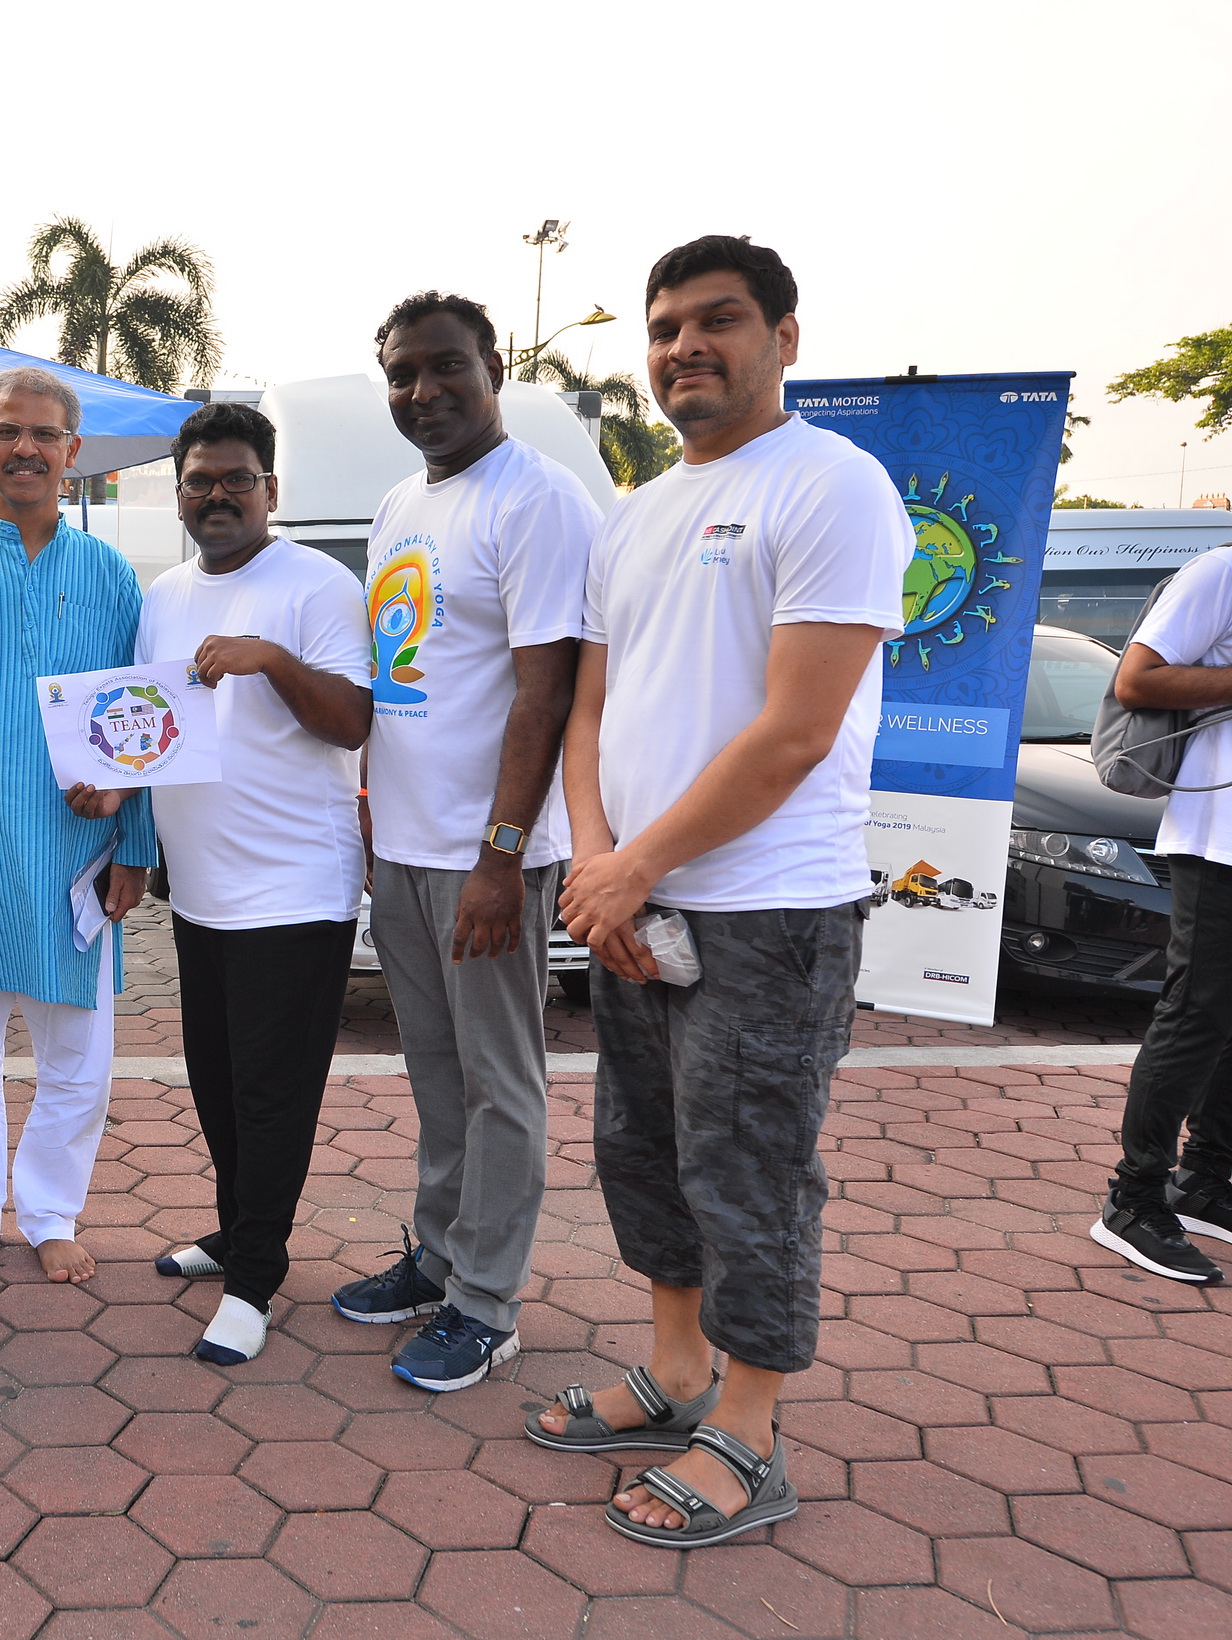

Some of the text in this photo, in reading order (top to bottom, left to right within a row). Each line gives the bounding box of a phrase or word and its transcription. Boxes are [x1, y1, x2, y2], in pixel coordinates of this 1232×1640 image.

[797, 396, 880, 408] TATA MOTORS
[1021, 391, 1058, 402] TATA
[800, 408, 879, 418] onnecting Aspirations
[425, 535, 437, 554] DAY
[1076, 544, 1110, 557] Our
[1115, 543, 1199, 563] Happiness
[432, 557, 441, 576] OF
[431, 583, 445, 628] YOGA
[83, 691, 97, 706] Telugu
[96, 679, 114, 691] Expats
[156, 681, 177, 699] Malaysia
[374, 707, 428, 718] ARMONY & PEACE
[109, 716, 157, 733] TEAM
[887, 714, 989, 736] WELLNESS
[873, 820, 891, 829] Yoga
[892, 822, 912, 830] 2019
[913, 824, 946, 834] Malaysia
[925, 971, 968, 983] DRB-HICOM
